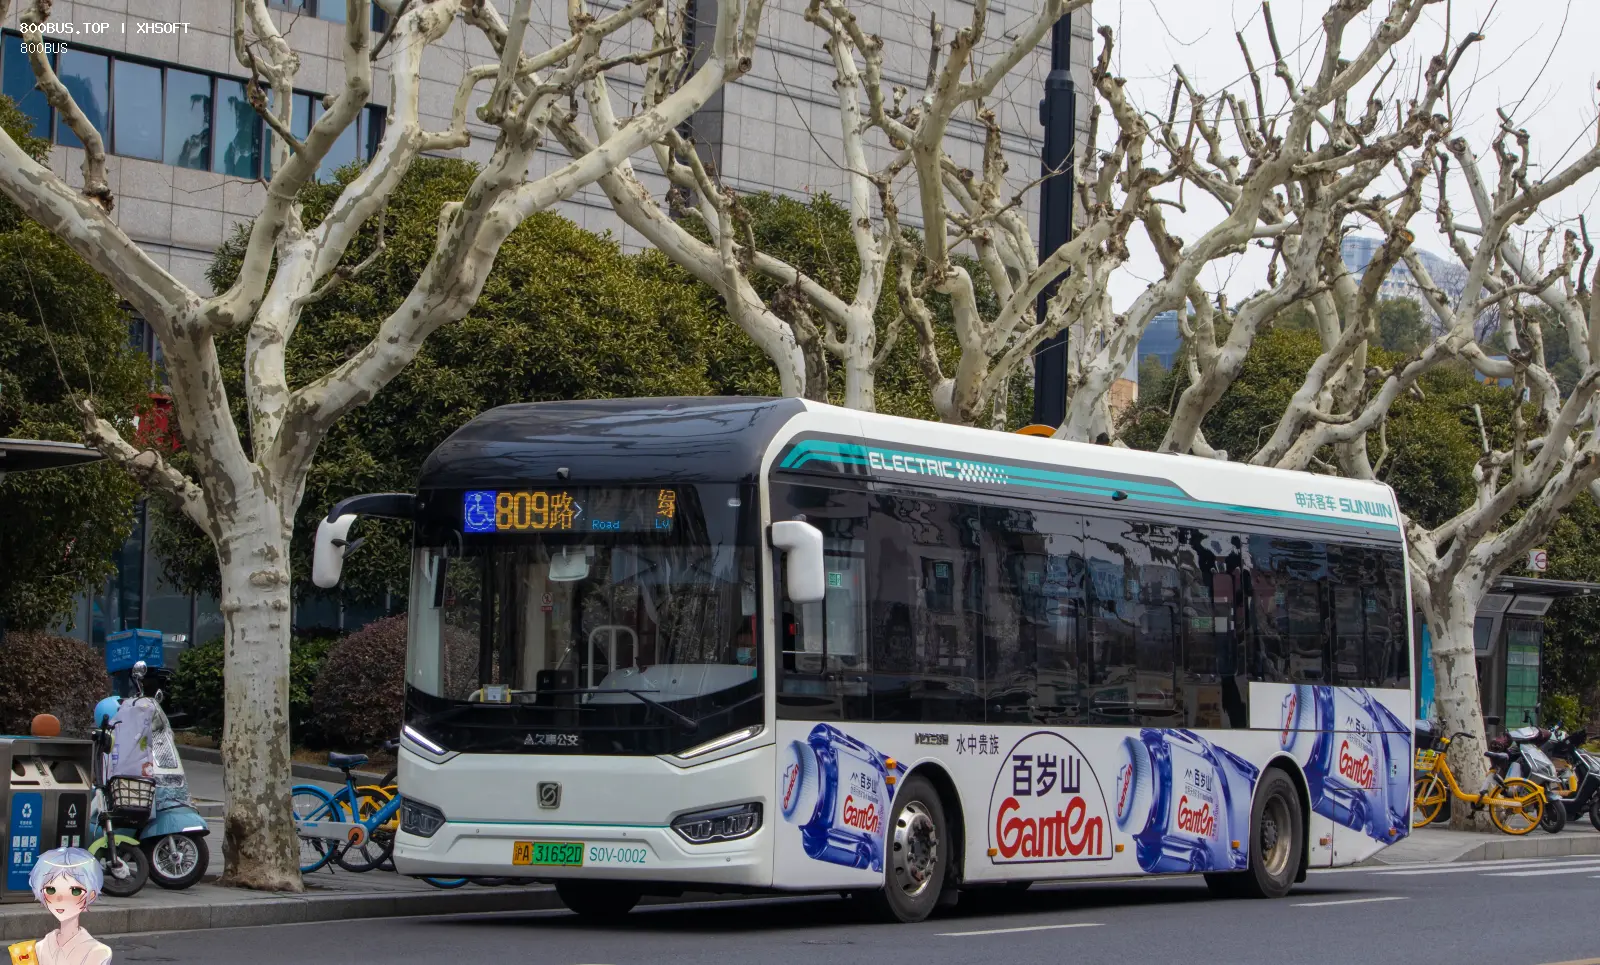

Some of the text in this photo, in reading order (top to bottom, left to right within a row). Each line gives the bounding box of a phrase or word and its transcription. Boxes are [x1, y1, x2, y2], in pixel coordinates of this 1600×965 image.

[868, 451, 955, 479] ELECTRIC
[496, 491, 574, 530] 809路
[1295, 491, 1337, 512] 申沃客车
[1338, 497, 1393, 519] SUNWIN
[592, 519, 621, 530] Road
[956, 733, 999, 755] 水中贵族
[1012, 753, 1081, 798] 百岁山
[1339, 739, 1373, 789] Ganten
[843, 794, 879, 833] Ganten
[996, 796, 1103, 859] Ganten
[1177, 794, 1214, 837] Ganten
